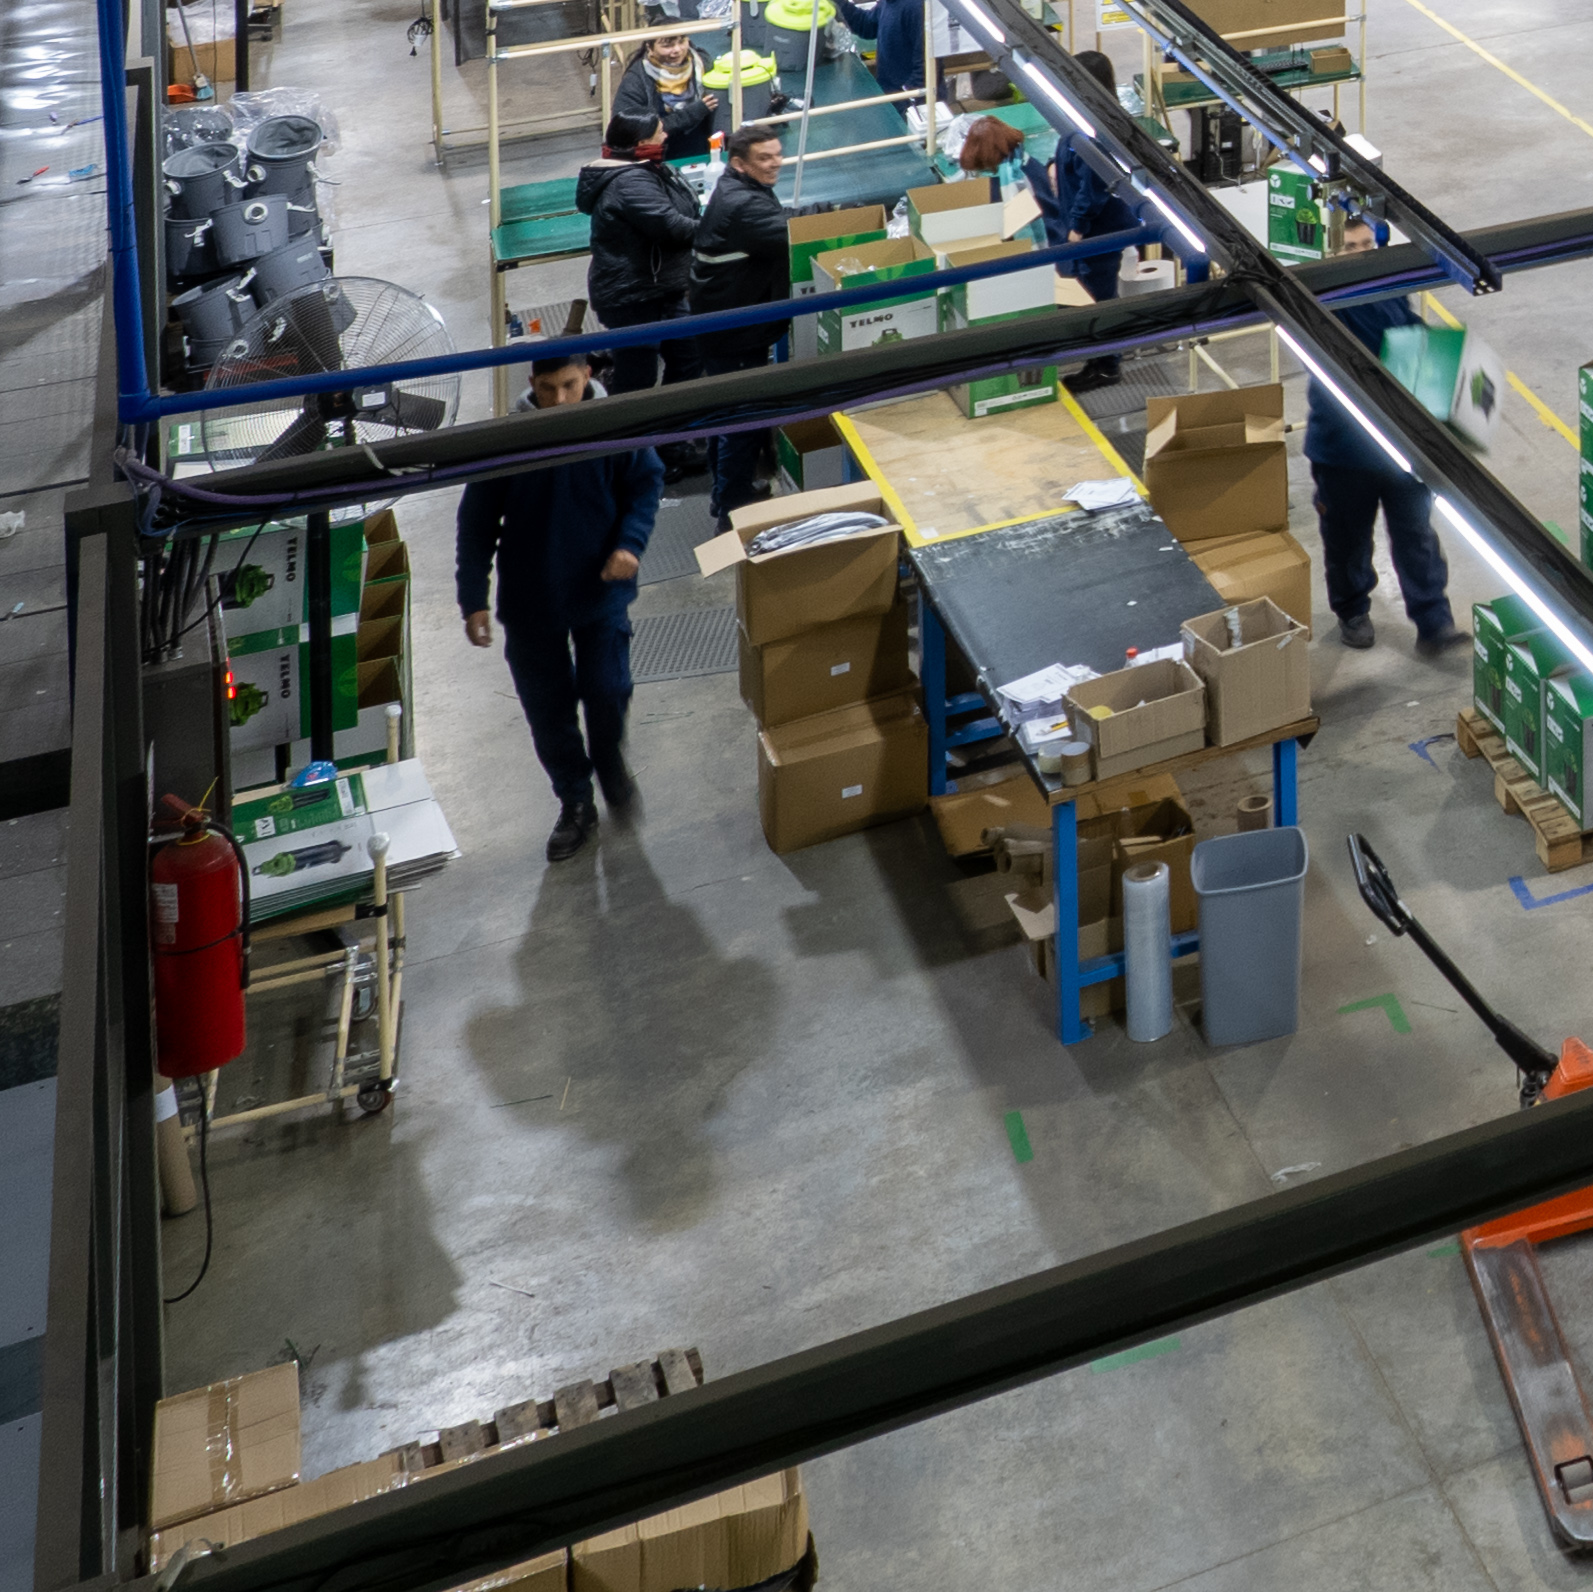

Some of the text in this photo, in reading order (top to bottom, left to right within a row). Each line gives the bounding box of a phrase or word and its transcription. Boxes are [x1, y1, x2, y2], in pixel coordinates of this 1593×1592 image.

[849, 313, 894, 329] YELMO
[286, 537, 299, 582] YELMO
[280, 654, 291, 699] YELMO
